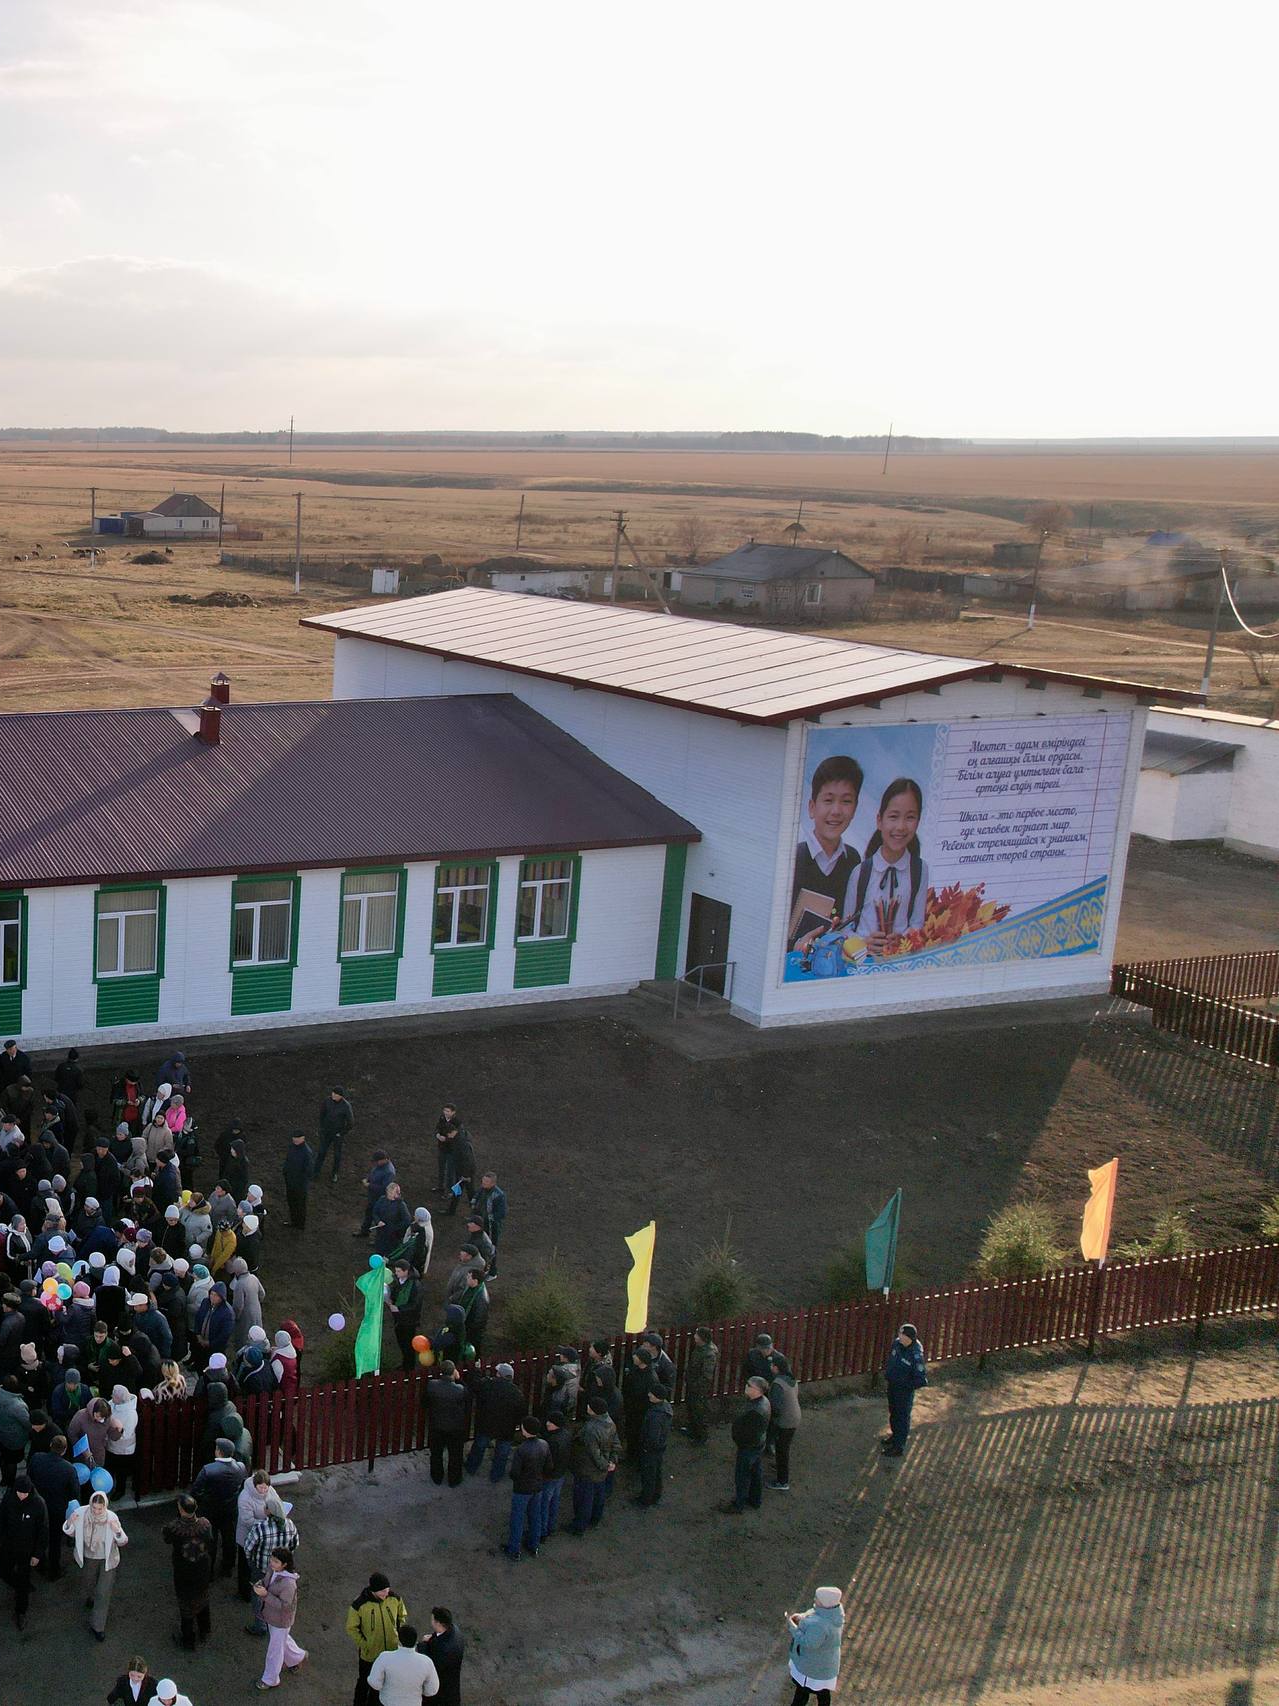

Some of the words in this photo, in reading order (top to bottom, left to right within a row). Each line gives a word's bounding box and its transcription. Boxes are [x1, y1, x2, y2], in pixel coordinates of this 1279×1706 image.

[1015, 741, 1039, 754] адам
[960, 810, 988, 822] Школа
[1016, 808, 1045, 823] первое
[960, 827, 974, 840] где
[977, 823, 1010, 835] человек
[959, 853, 994, 864] станет
[996, 850, 1027, 864] опорой
